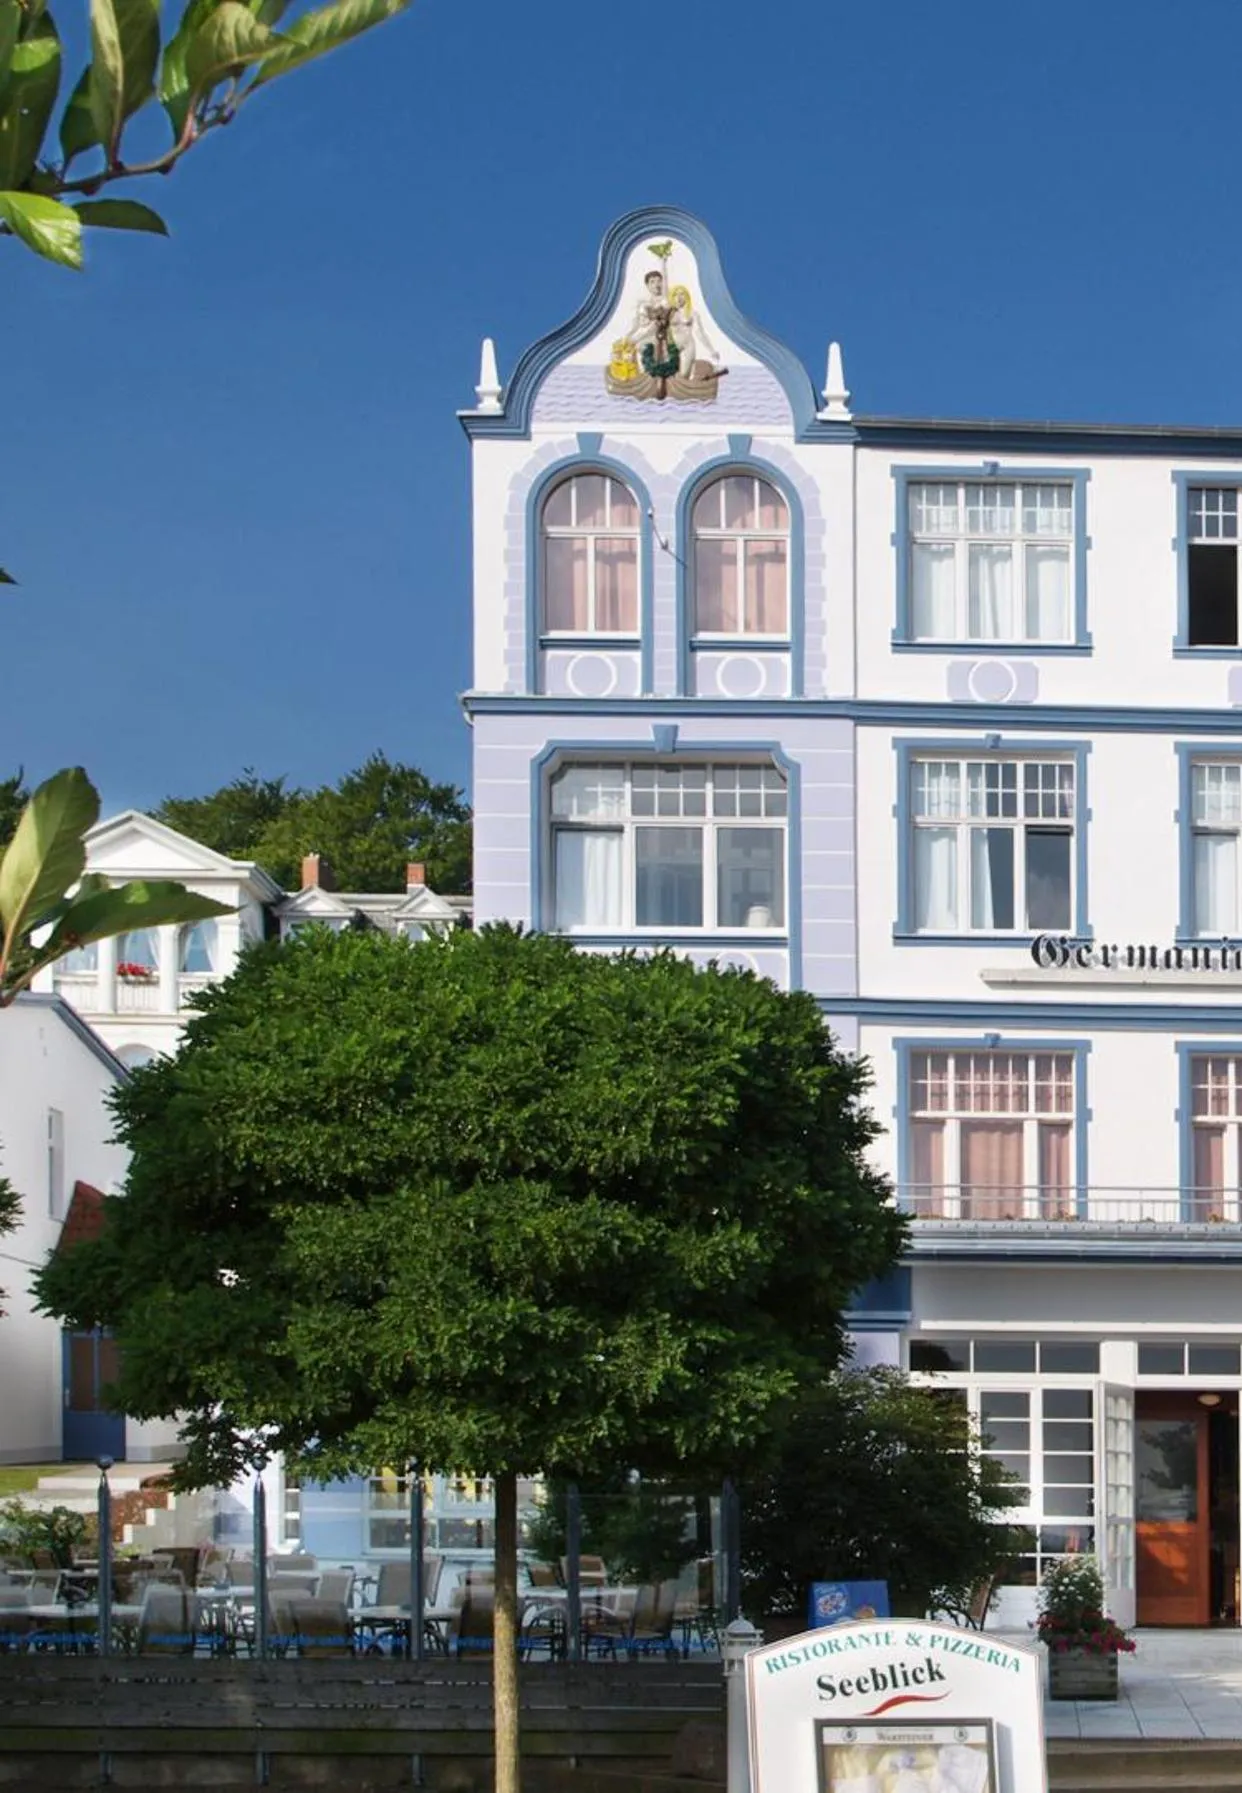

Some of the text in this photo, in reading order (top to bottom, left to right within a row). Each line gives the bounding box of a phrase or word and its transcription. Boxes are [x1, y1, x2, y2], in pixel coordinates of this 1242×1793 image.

[765, 1630, 1023, 1676] RISTORANTE & PIZZERIA
[816, 1657, 947, 1701] Seeblick
